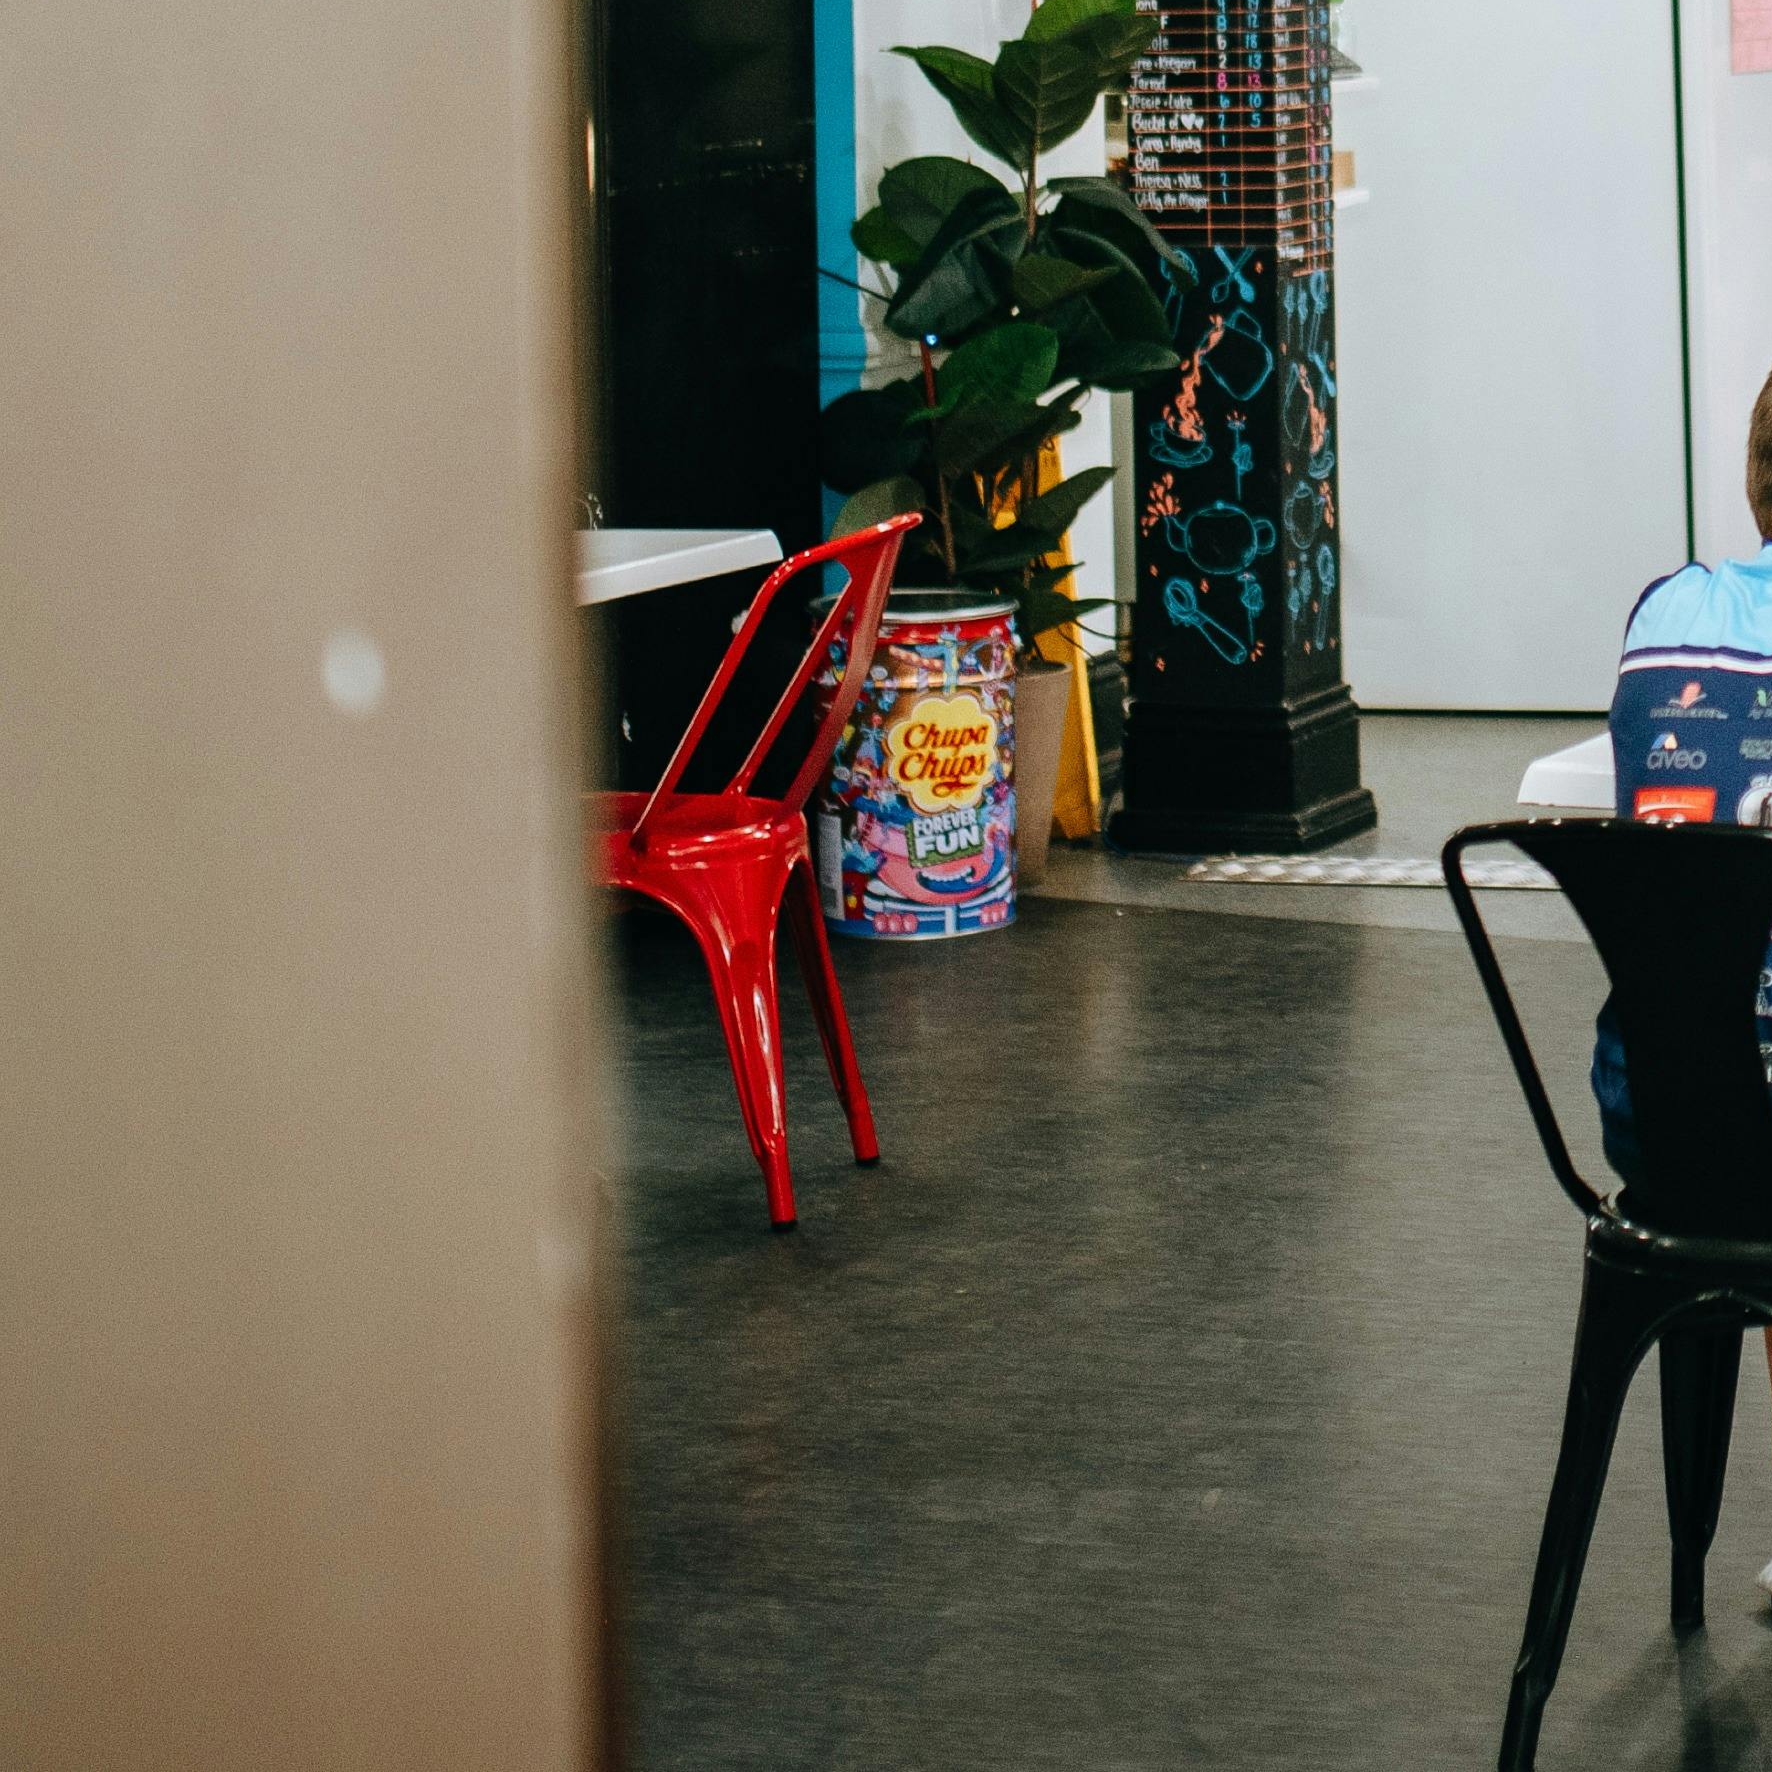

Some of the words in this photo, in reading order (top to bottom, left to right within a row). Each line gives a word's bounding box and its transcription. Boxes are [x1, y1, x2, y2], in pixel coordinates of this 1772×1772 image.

[1250, 113, 1261, 129] 5
[1134, 153, 1160, 172] Ben
[903, 723, 989, 755] Chupa
[898, 750, 987, 784] Chups
[1646, 748, 1708, 771] aveo
[911, 807, 978, 838] FOREVER
[914, 824, 981, 860] FUN
